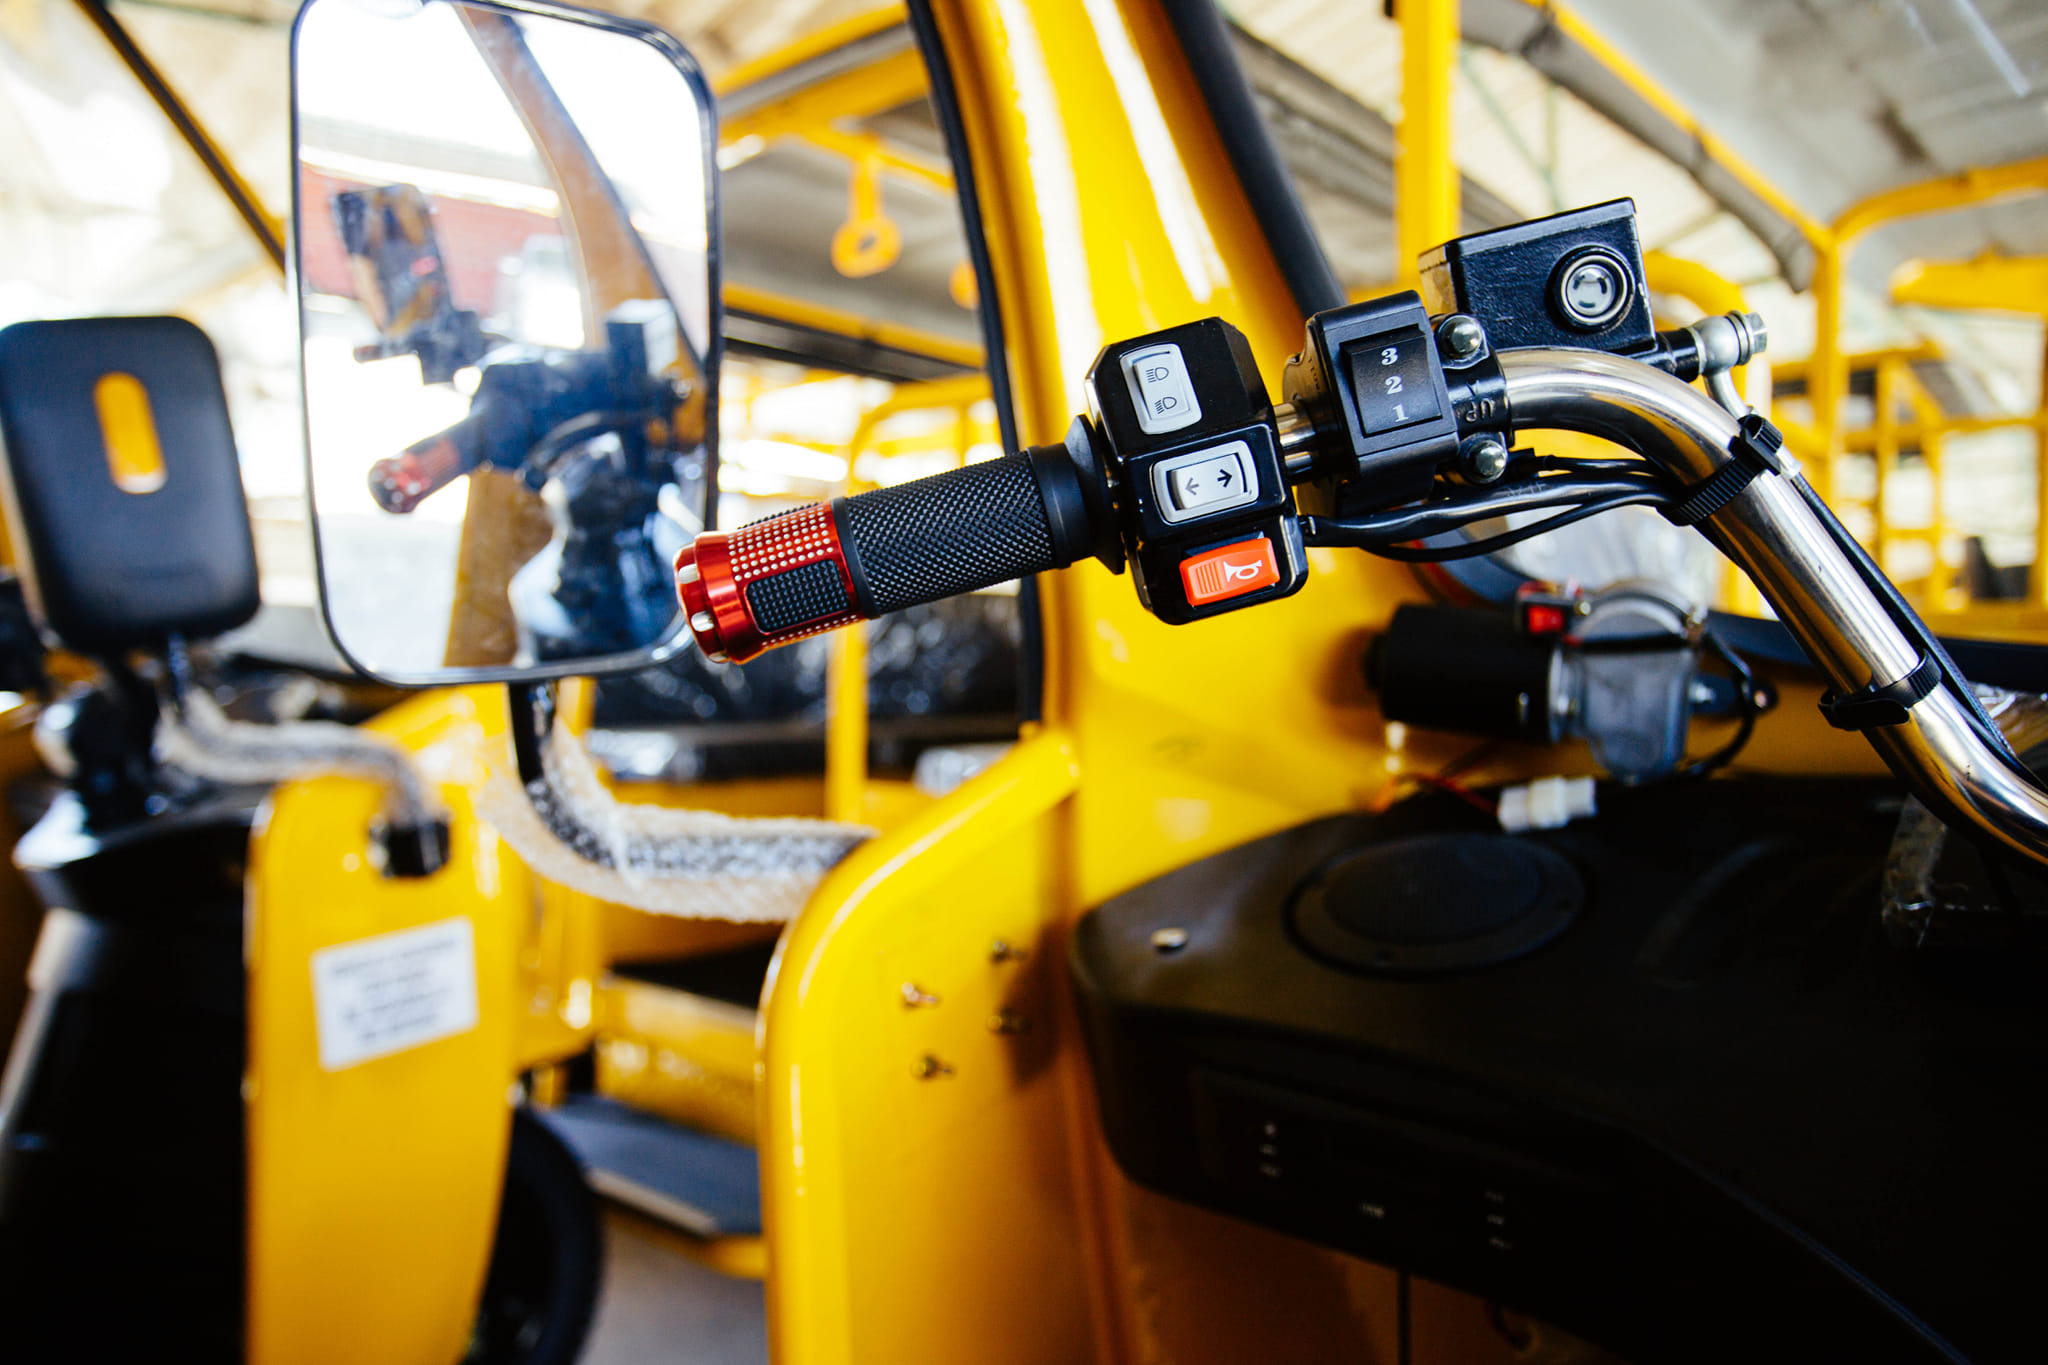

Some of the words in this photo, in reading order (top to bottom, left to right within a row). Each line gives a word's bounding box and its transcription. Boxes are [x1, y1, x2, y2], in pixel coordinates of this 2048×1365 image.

[1382, 347, 1398, 365] 3
[1385, 375, 1403, 395] 2
[1393, 404, 1408, 423] 1
